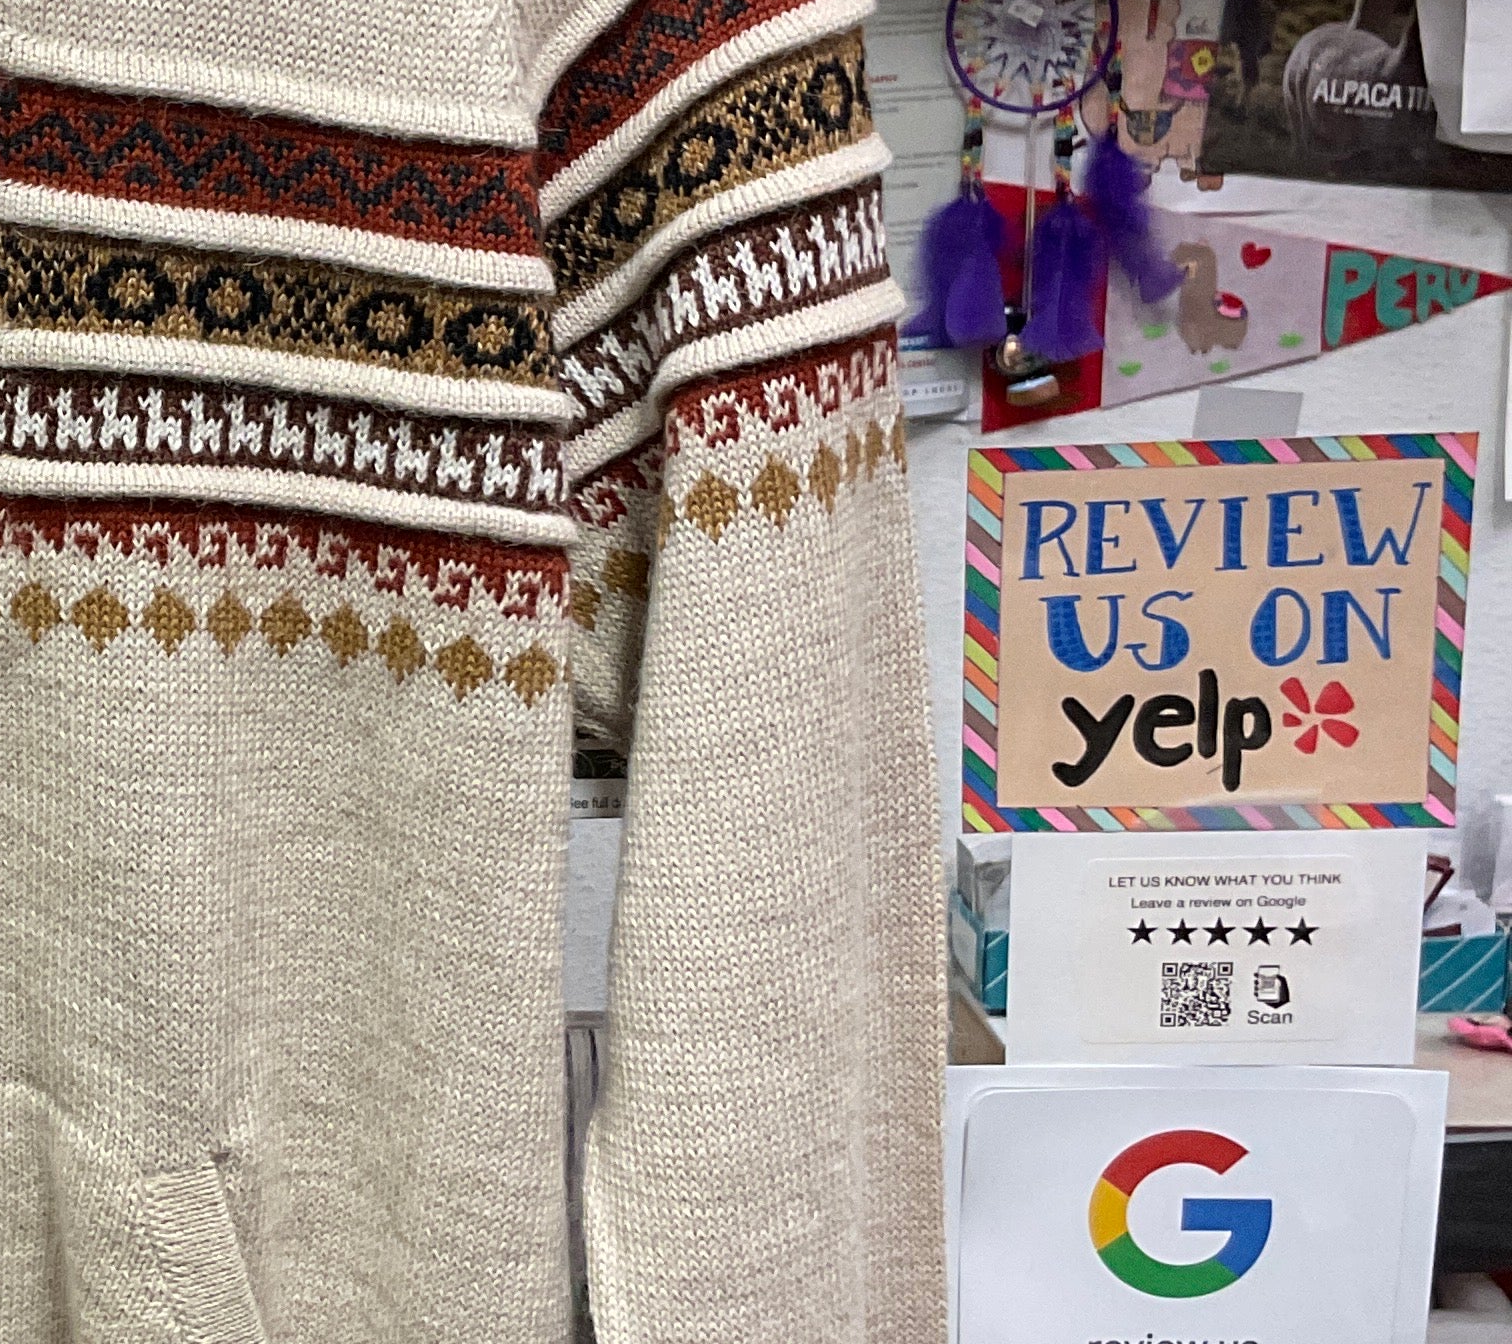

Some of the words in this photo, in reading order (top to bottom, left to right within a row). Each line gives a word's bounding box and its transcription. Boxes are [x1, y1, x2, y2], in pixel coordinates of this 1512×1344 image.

[1312, 77, 1403, 111] ALPACA
[1322, 249, 1480, 348] PERU
[1018, 481, 1433, 581] REVIEW
[1038, 589, 1194, 673] US
[1249, 587, 1402, 667] ON
[1051, 669, 1272, 792] yelp
[1108, 876, 1136, 888] LET
[1140, 876, 1161, 887] US
[1164, 875, 1211, 887] KNOW
[1214, 875, 1258, 886] WHAT
[1261, 874, 1293, 886] YOU
[1298, 873, 1342, 885] THINK
[1130, 897, 1172, 909] Leave
[1176, 899, 1185, 908] a
[1189, 897, 1232, 908] review
[1235, 898, 1253, 908] on
[1257, 895, 1307, 909] Google
[1247, 1009, 1293, 1025] Scan
